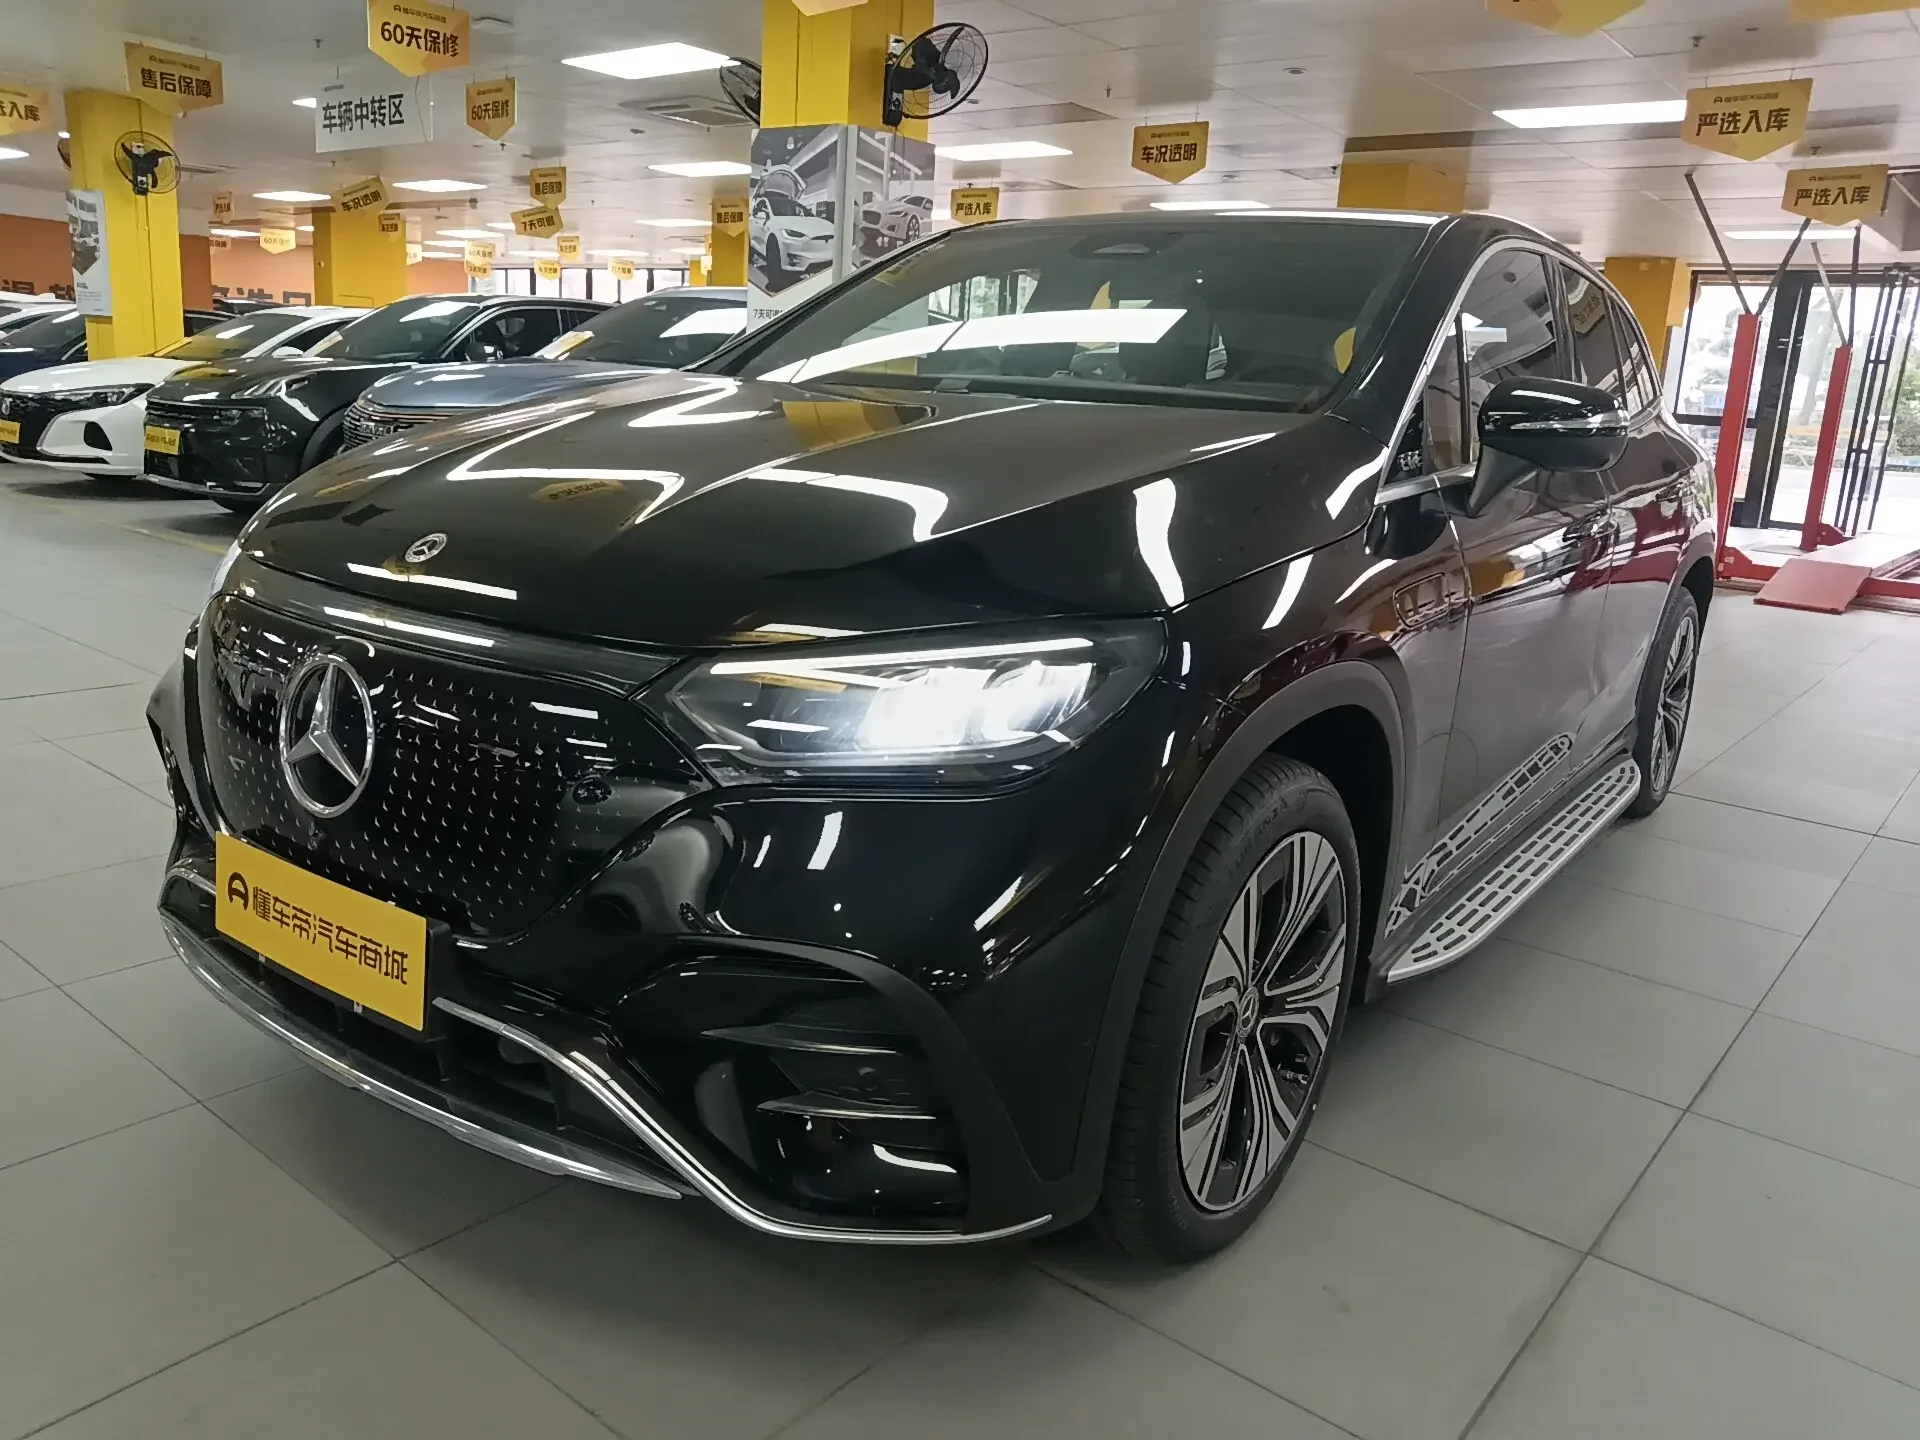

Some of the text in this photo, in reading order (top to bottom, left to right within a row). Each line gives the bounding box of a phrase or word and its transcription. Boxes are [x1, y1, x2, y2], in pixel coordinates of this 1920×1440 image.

[381, 21, 459, 58] 60天保修
[141, 67, 212, 99] 售后保障
[322, 93, 404, 134] 车辆中转区
[471, 99, 510, 121] 60天保修
[1695, 107, 1791, 137] 严选入库
[1140, 142, 1198, 164] 车况透明
[955, 202, 993, 216] 严选入库
[1793, 185, 1871, 207] 严选入库
[753, 308, 784, 320] 7天可退
[252, 885, 409, 986] 懂车帝汽车商城
